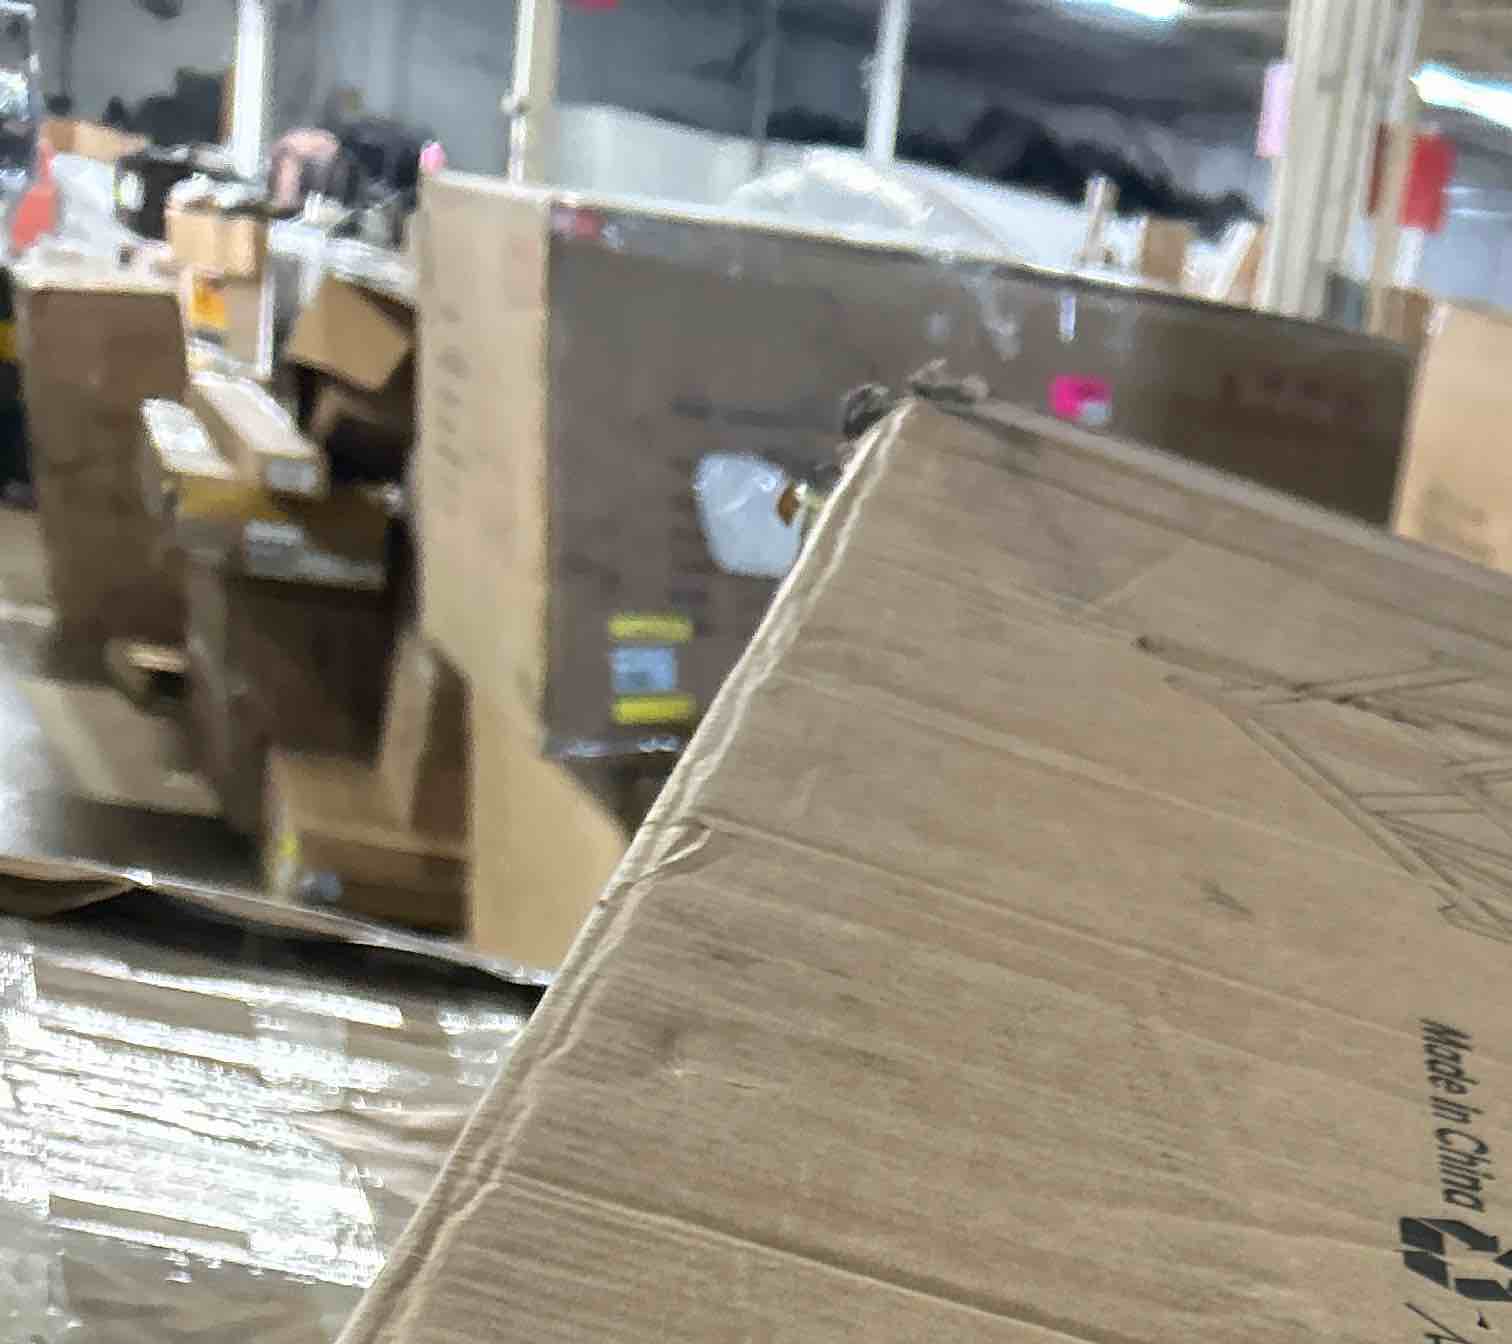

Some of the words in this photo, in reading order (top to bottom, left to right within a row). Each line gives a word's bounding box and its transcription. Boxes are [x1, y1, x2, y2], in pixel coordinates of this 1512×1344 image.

[1419, 1017, 1481, 1095] Made
[1429, 1096, 1485, 1124] in
[1435, 1127, 1496, 1213] China
